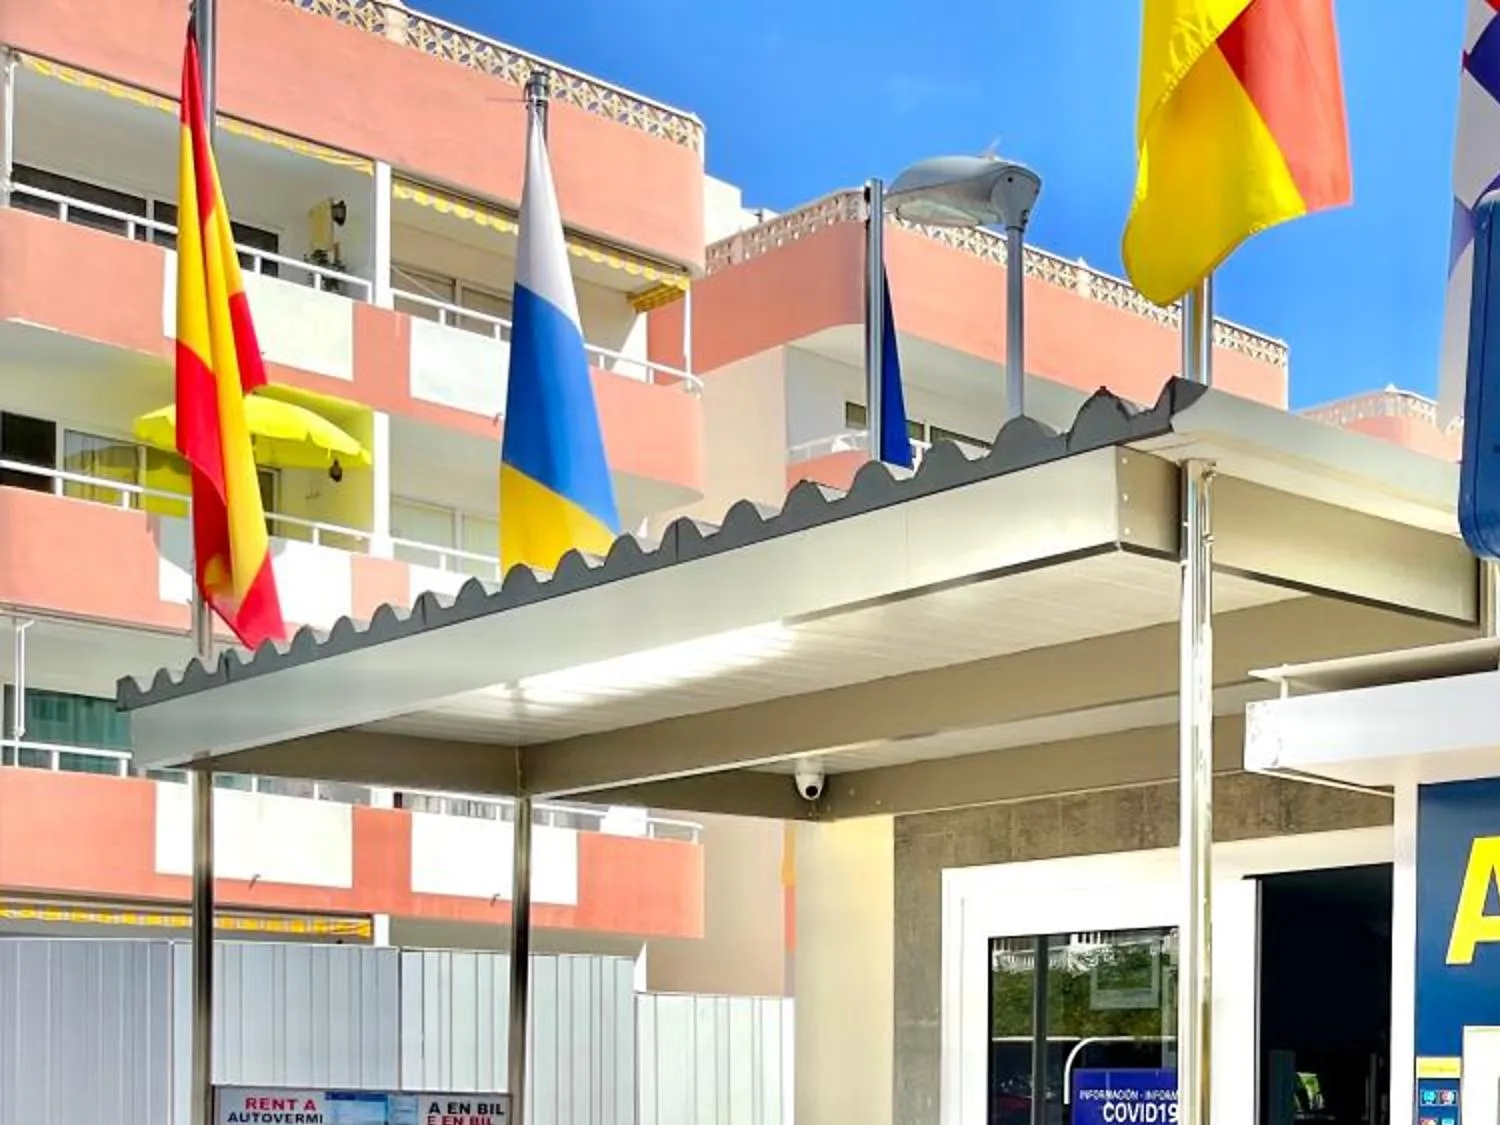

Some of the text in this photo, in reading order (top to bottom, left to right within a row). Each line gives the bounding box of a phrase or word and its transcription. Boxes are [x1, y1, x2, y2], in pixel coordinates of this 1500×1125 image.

[245, 1098, 317, 1112] RENT A
[447, 1101, 471, 1115] EN
[477, 1102, 505, 1116] BIL
[1103, 1102, 1178, 1123] COVID19
